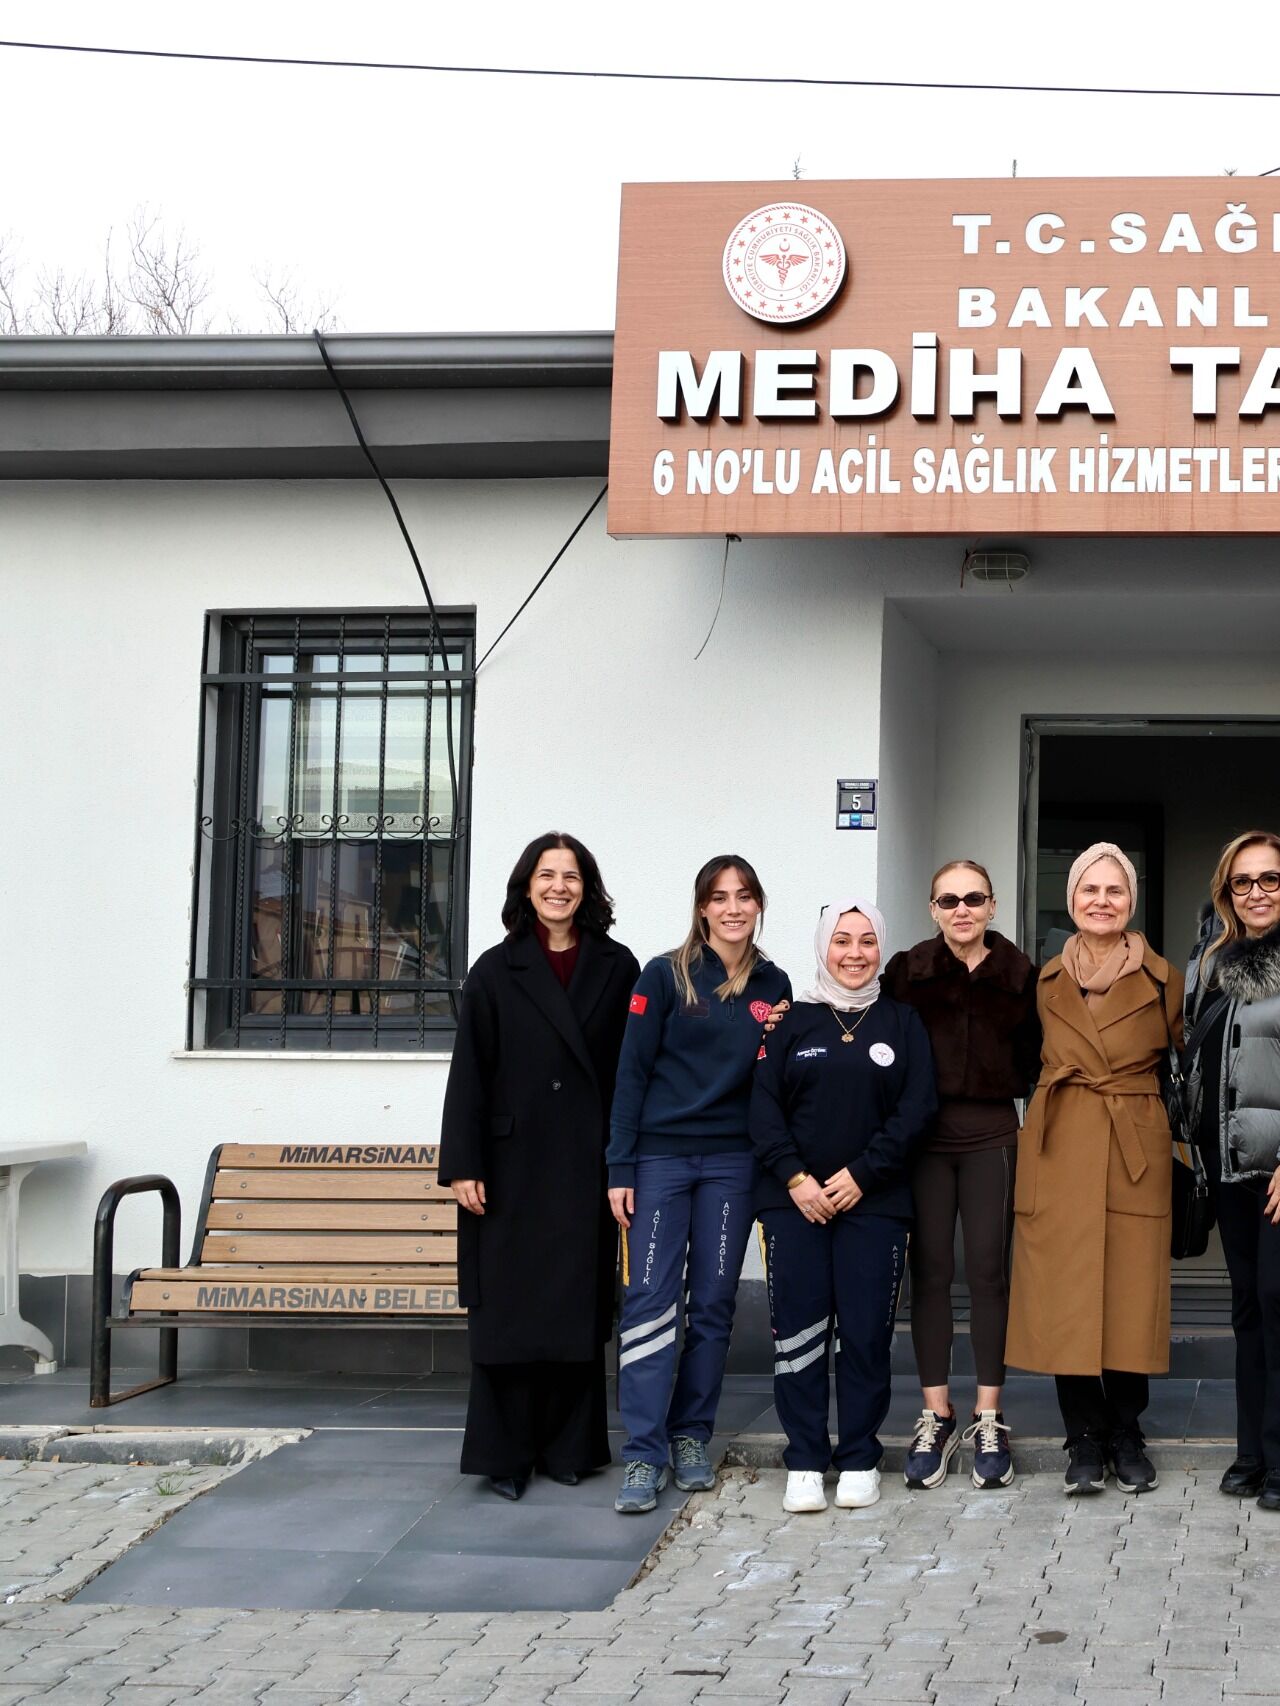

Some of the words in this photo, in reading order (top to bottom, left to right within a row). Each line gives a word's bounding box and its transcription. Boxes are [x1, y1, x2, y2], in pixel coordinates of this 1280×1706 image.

[656, 331, 1117, 420] MEDİHA
[653, 448, 675, 496] 6
[811, 434, 901, 495] ACİL
[912, 432, 1057, 494] SAĞLIK
[852, 794, 862, 811] 5
[374, 1288, 459, 1310] BELED
